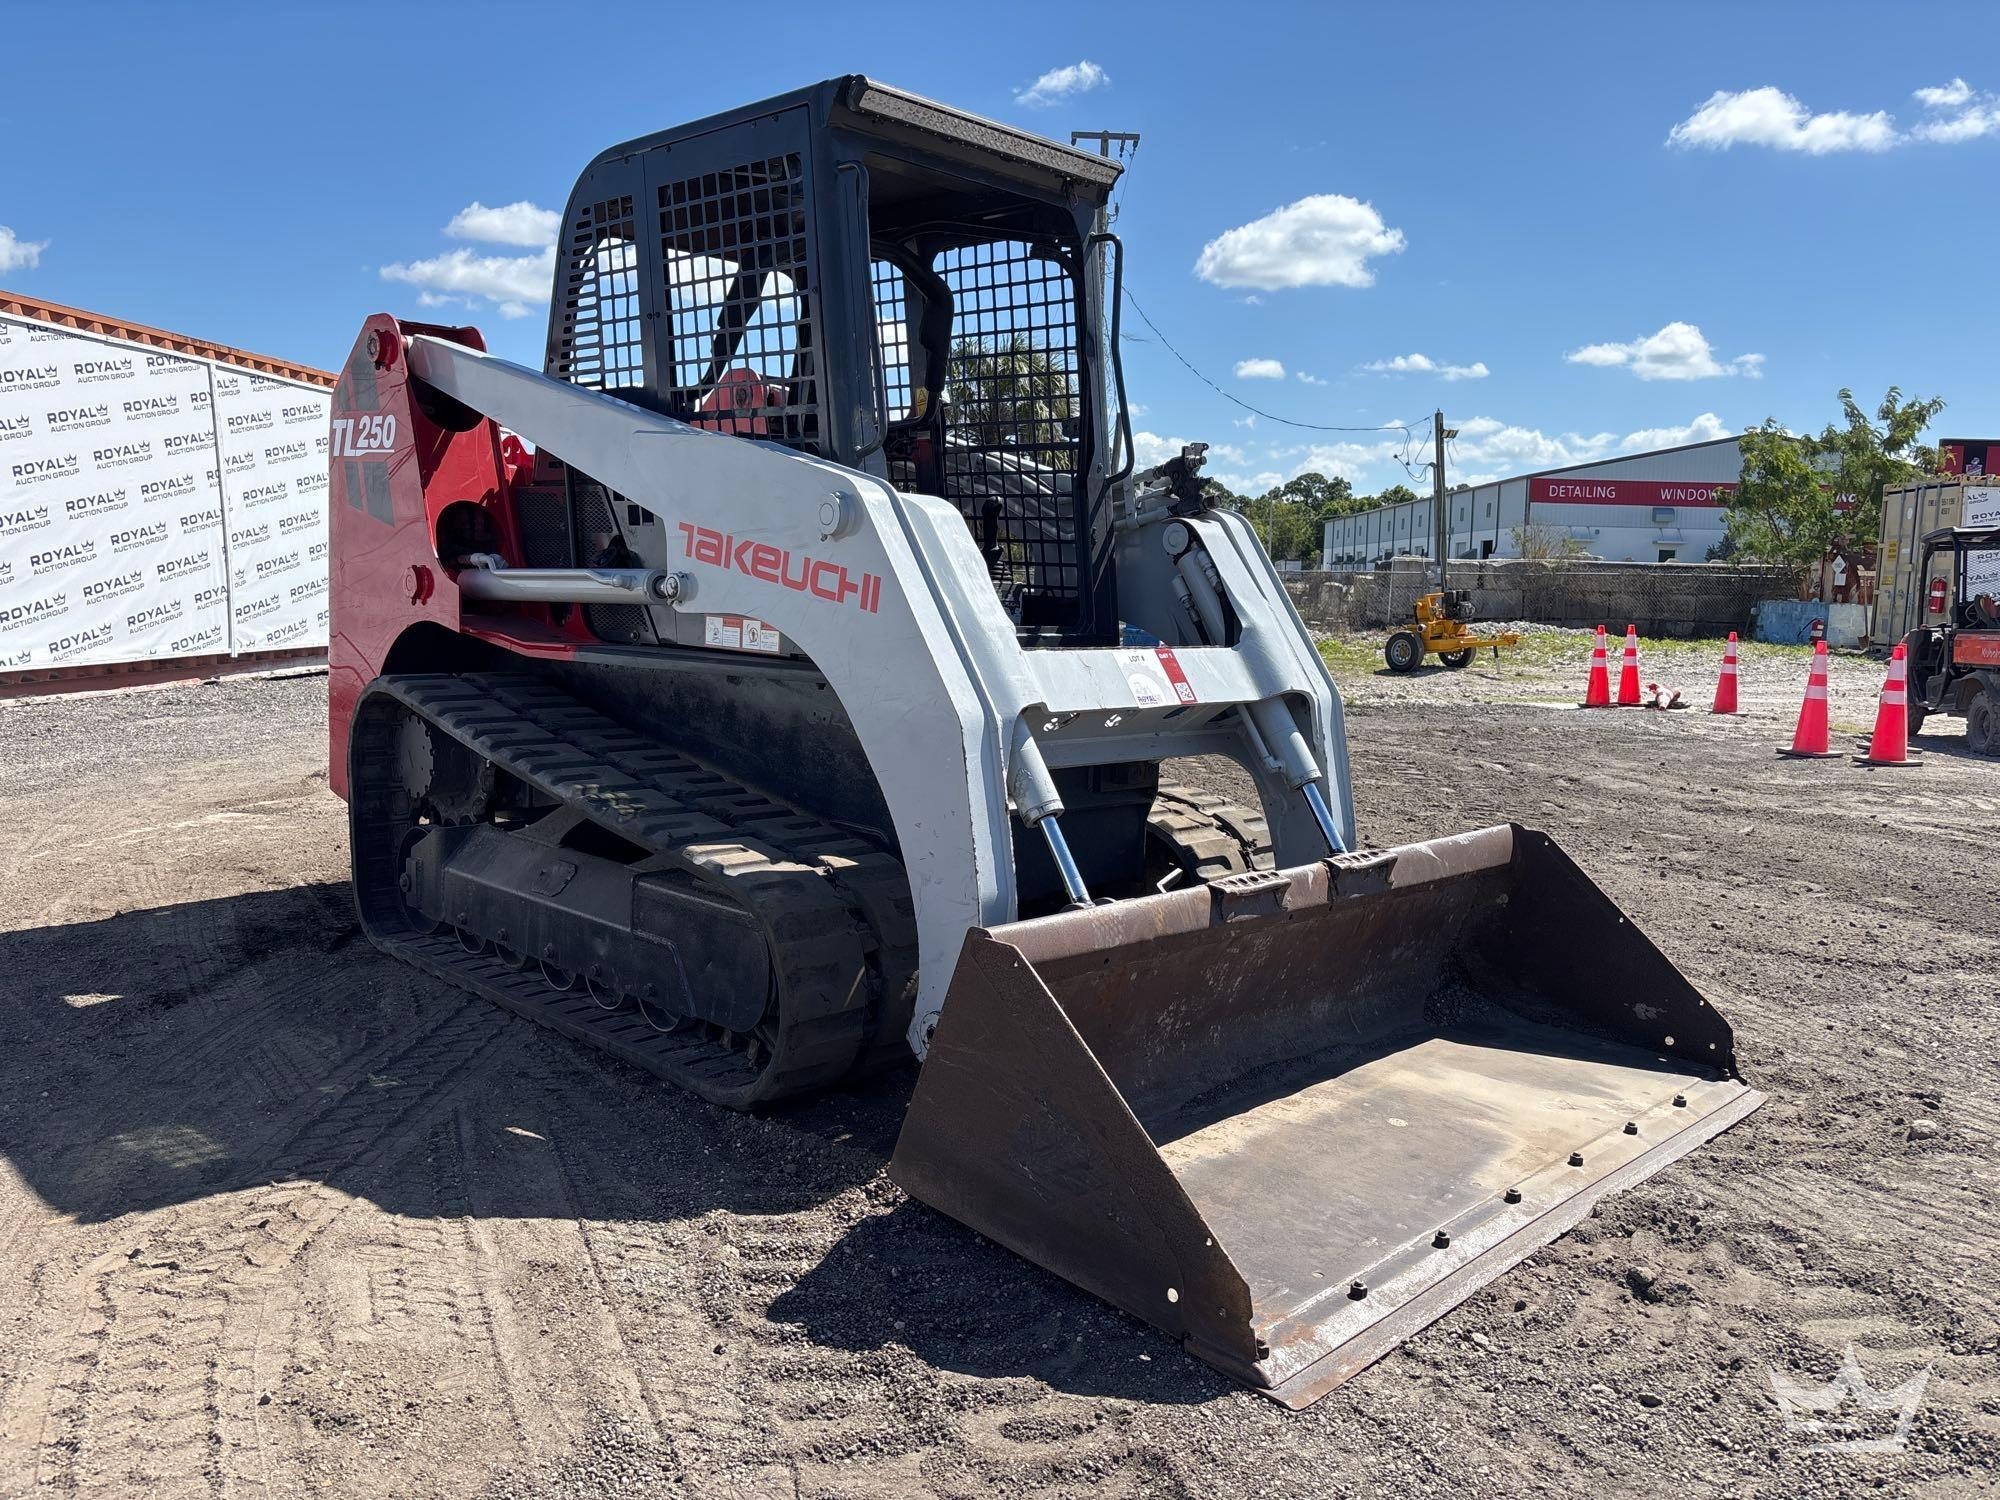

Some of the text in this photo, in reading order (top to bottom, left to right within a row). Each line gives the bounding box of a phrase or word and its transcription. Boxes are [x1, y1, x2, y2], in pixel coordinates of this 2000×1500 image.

[31, 333, 65, 342] AUCTION
[74, 360, 121, 375] ROYAL
[150, 365, 200, 376] AUCTION GROUP
[0, 379, 61, 393] UCTION GROUP
[78, 372, 135, 384] AUCTION GROUP
[222, 389, 240, 397] GROUP
[252, 384, 275, 392] AUCTION
[123, 398, 167, 412] ROYAL
[282, 405, 314, 418] ROYAL
[47, 407, 97, 424] ROYAL
[127, 408, 179, 421] AUCTION GROUP
[228, 414, 263, 427] ROYAL
[285, 413, 323, 425] AUCTION GROUP
[51, 418, 111, 433] AUCTION GROUP
[230, 422, 274, 435] AUCTION GROUP
[4, 430, 33, 441] GROUP
[164, 433, 205, 448] ROYAL
[93, 444, 139, 461] ROYAL
[168, 446, 195, 456] AUCTION
[265, 444, 298, 458] ROYAL
[267, 451, 308, 465] AUCTION GROUP
[12, 458, 65, 477] ROYAL
[97, 453, 152, 470] AUCTION GROUP
[237, 463, 256, 472] GROUP
[16, 467, 80, 486] AUCTION GROUP
[140, 478, 183, 495] ROYAL
[144, 486, 196, 503] AUCTION GROUP
[243, 485, 278, 501] ROYAL
[299, 485, 320, 495] AUCTION
[1549, 485, 1616, 499] DETAILING
[65, 493, 115, 512] ROYAL
[245, 492, 288, 508] AUCTION GROUP
[69, 501, 128, 521] AUCTION GROUP
[180, 509, 220, 527] ROYAL
[22, 519, 51, 532] GROUP
[279, 513, 312, 528] ROYAL
[282, 519, 321, 535] AUCTION GROUP
[110, 526, 156, 545] ROYAL
[183, 524, 211, 534] AUCTION
[114, 533, 169, 553] AUCTION GROUP
[250, 534, 270, 545] GROUP
[30, 545, 82, 567] ROYAL
[257, 555, 291, 573] ROYAL
[33, 553, 97, 576] AUCTION GROUP
[157, 556, 198, 575] ROYAL
[160, 562, 211, 583] AUCTION GROUP
[259, 561, 300, 580] AUCTION GROUP
[83, 576, 131, 598] ROYAL
[86, 582, 145, 606] AUCTION GROUP
[290, 579, 321, 598] ROYAL
[292, 593, 313, 605] AUCTION
[127, 605, 171, 627] ROYAL
[235, 599, 271, 618] ROYAL
[237, 604, 280, 624] AUCTION GROUP
[2, 606, 69, 633] AUCTION GROUP
[129, 611, 183, 635] AUCTION GROUP
[267, 623, 299, 642] ROYAL
[291, 629, 309, 640] GROUP
[49, 629, 100, 654] ROYAL
[53, 635, 114, 662] AUCTION GROUP
[171, 631, 211, 652] ROYAL
[202, 637, 222, 649] GROUP
